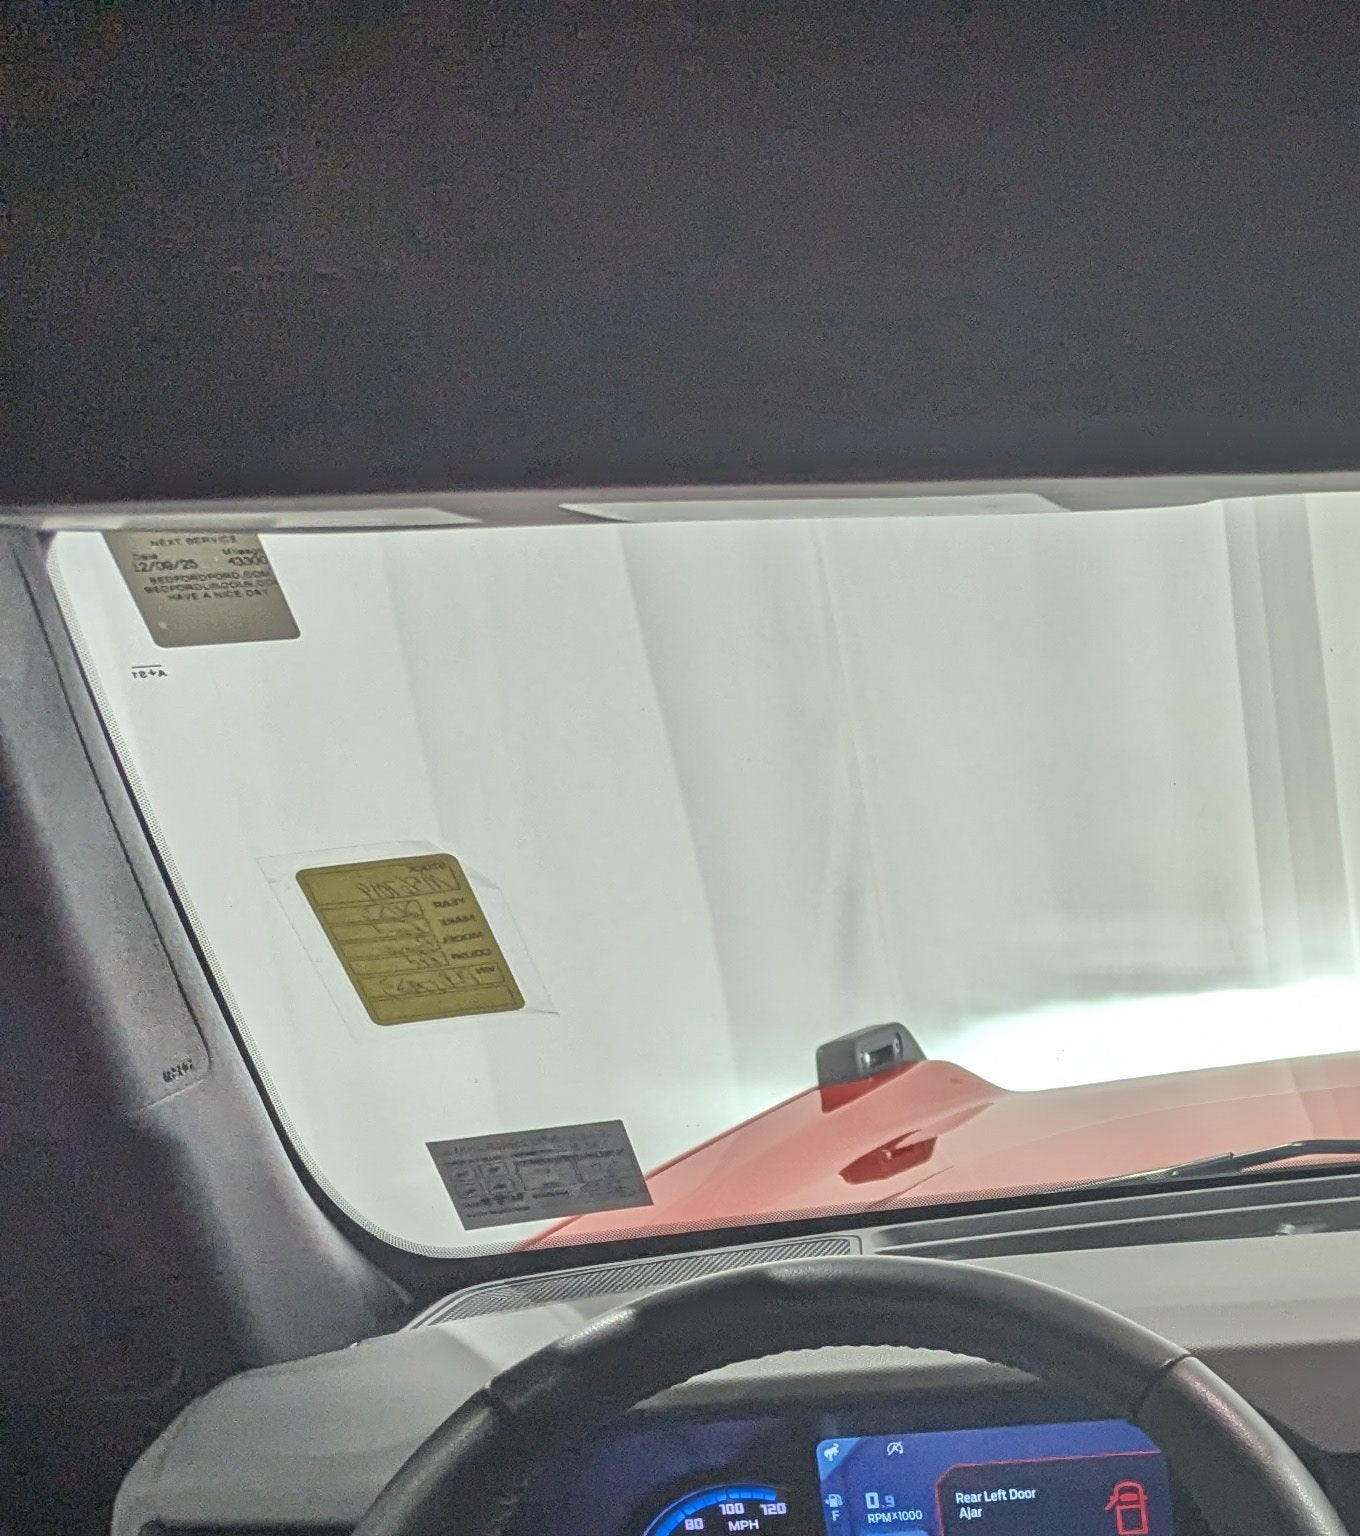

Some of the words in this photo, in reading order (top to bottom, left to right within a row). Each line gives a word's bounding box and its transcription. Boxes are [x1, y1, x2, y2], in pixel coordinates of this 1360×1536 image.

[150, 538, 180, 546] NEXT
[186, 535, 236, 544] SERVICE
[865, 1492, 895, 1508] 0.9
[955, 1492, 982, 1504] Rear
[984, 1489, 1007, 1502] Left
[1009, 1488, 1036, 1500] Door
[719, 1503, 744, 1515] 100
[760, 1502, 787, 1515] 120
[959, 1507, 982, 1520] Ajar
[832, 1510, 840, 1521] F
[684, 1518, 704, 1530] 80
[728, 1519, 759, 1531] MPH
